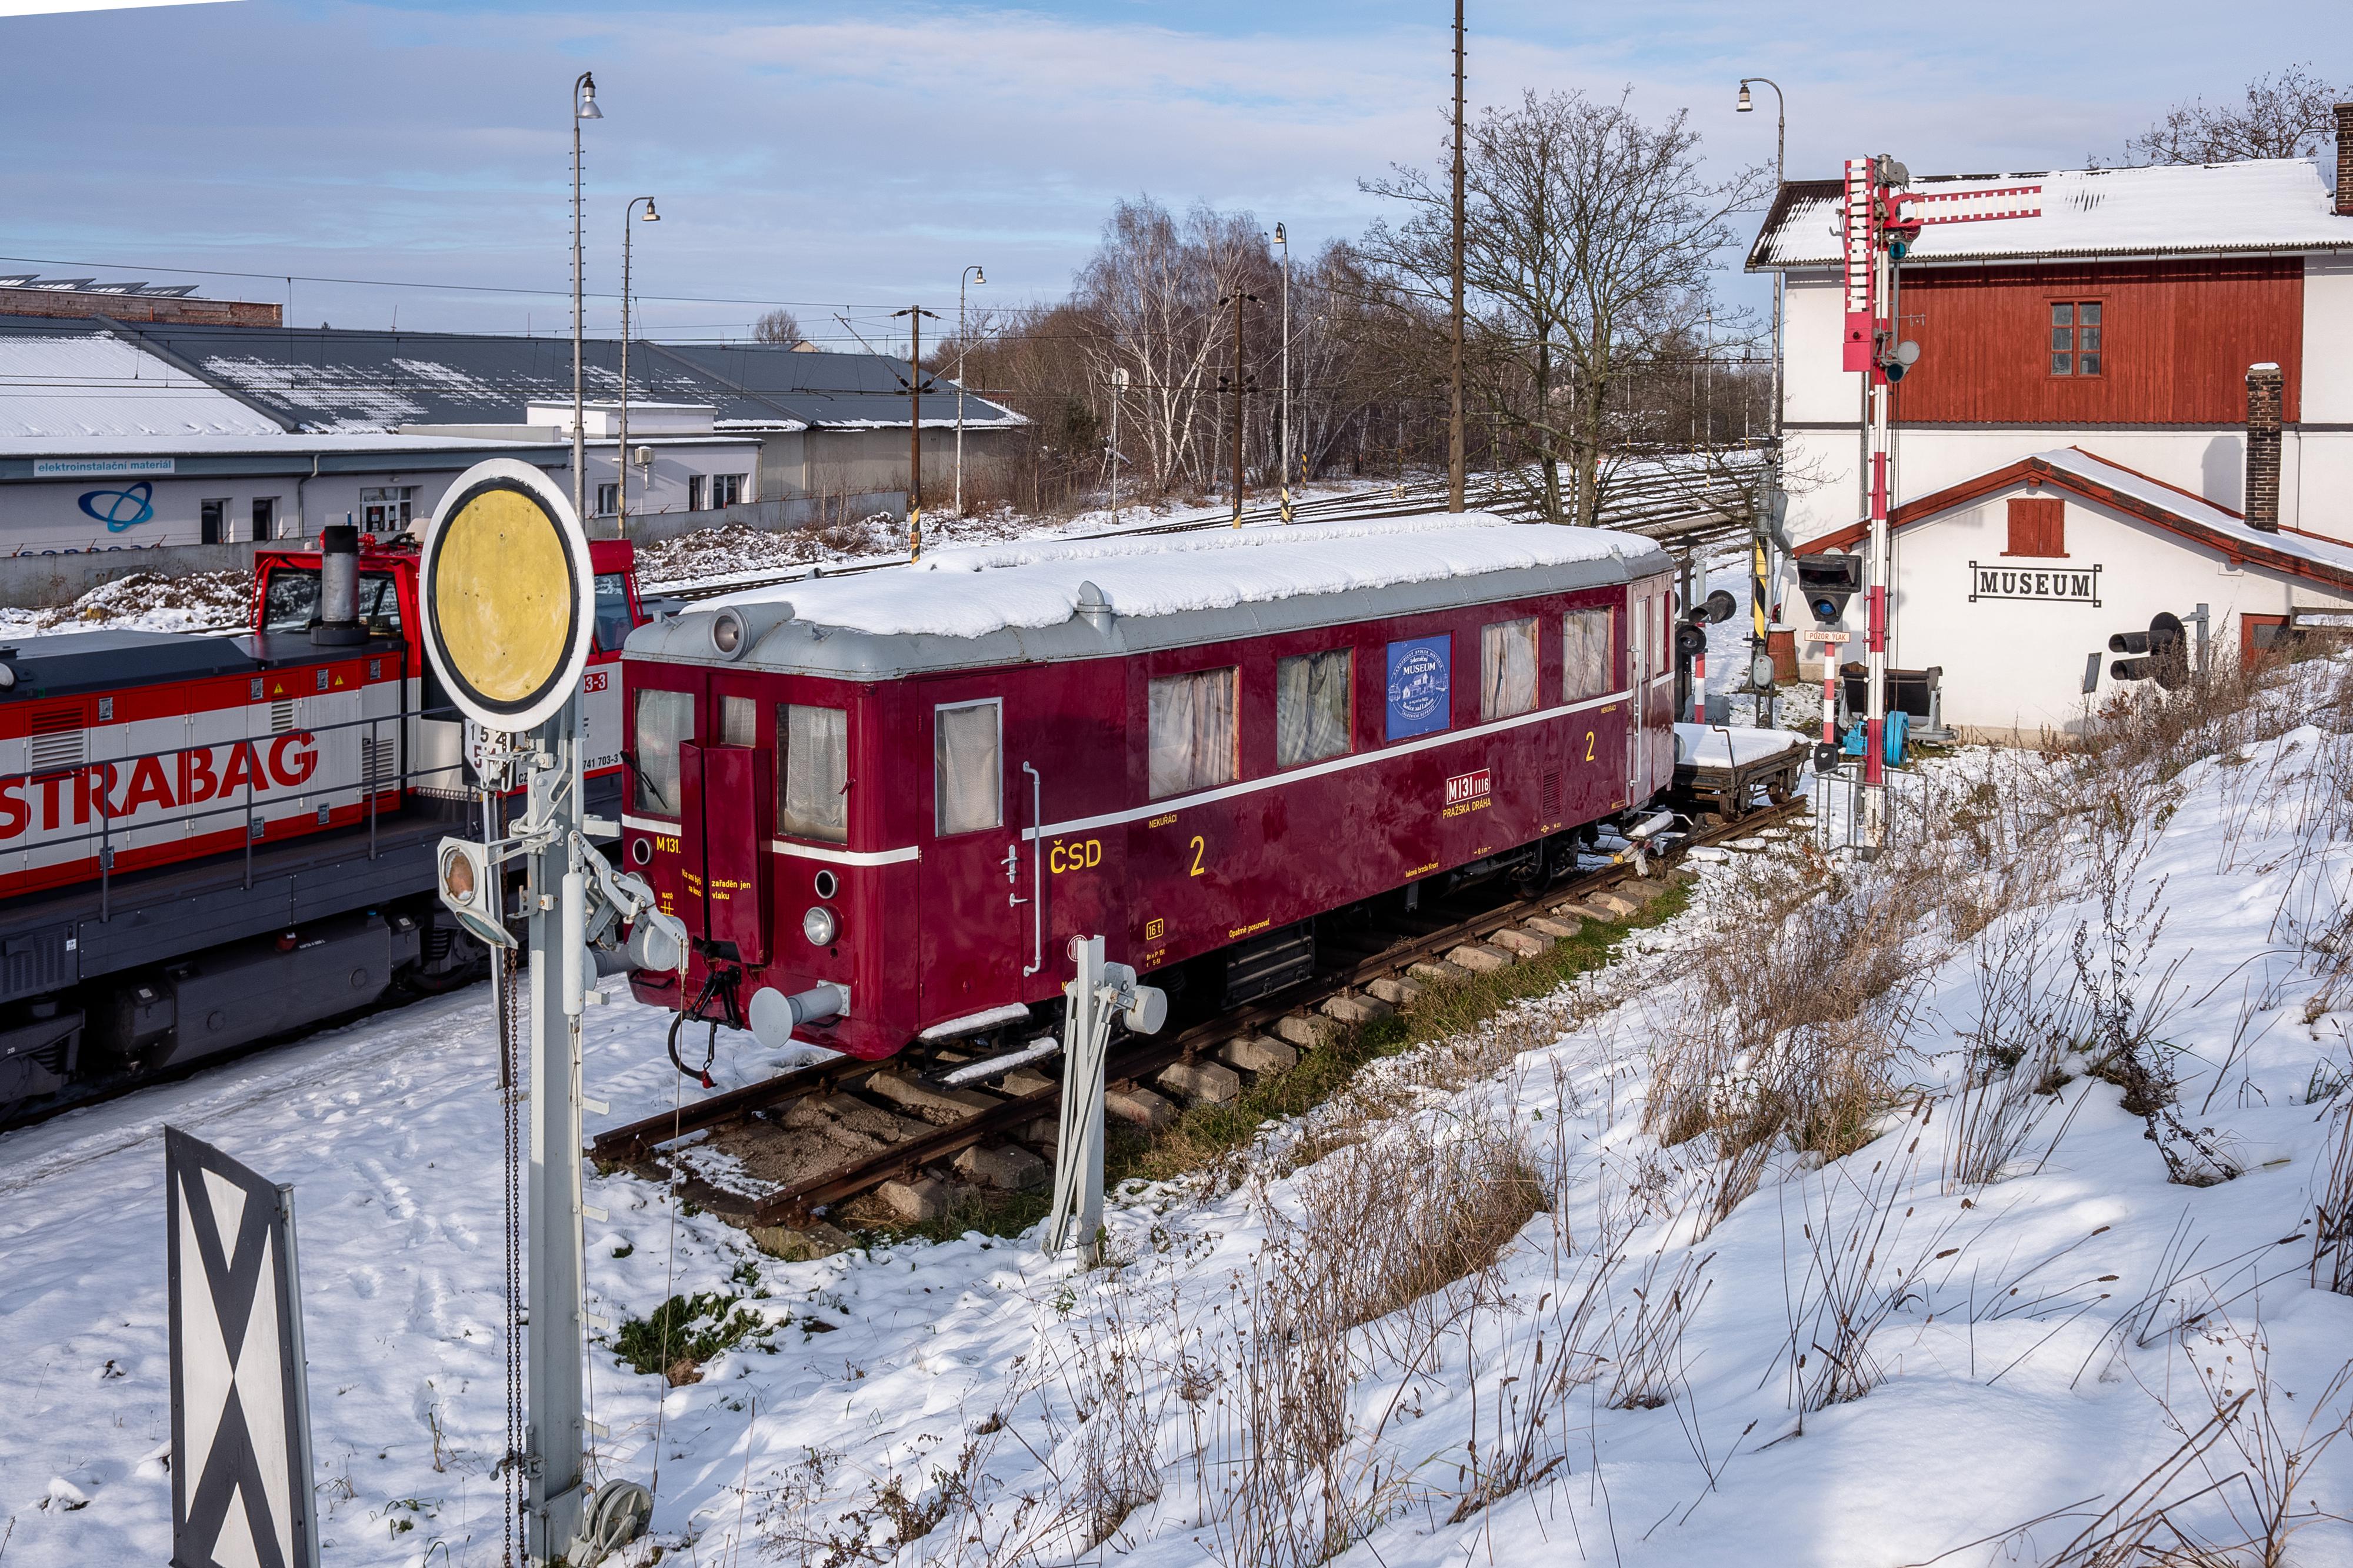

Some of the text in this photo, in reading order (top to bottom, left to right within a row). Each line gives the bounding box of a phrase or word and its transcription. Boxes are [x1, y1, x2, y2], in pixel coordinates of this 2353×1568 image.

[38, 459, 171, 472] elektroinstalační materiál
[1980, 571, 2090, 596] MUSEUM
[1403, 662, 1436, 675] MUSEUM
[584, 674, 606, 692] 3-3
[1586, 731, 1594, 762] 2
[598, 754, 618, 766] 703-3
[0, 729, 318, 839] STRABAG
[1443, 798, 1491, 819] PRAŽSKÁ DRÁHA
[1149, 814, 1176, 829] NEKUŘÁCI
[1051, 839, 1101, 874] ČSD
[1190, 835, 1205, 876] 2
[711, 879, 751, 890] zařaděn jen
[712, 891, 729, 899] vlaku
[1149, 925, 1156, 936] 16
[1229, 918, 1269, 939] Opatrně posunovat
